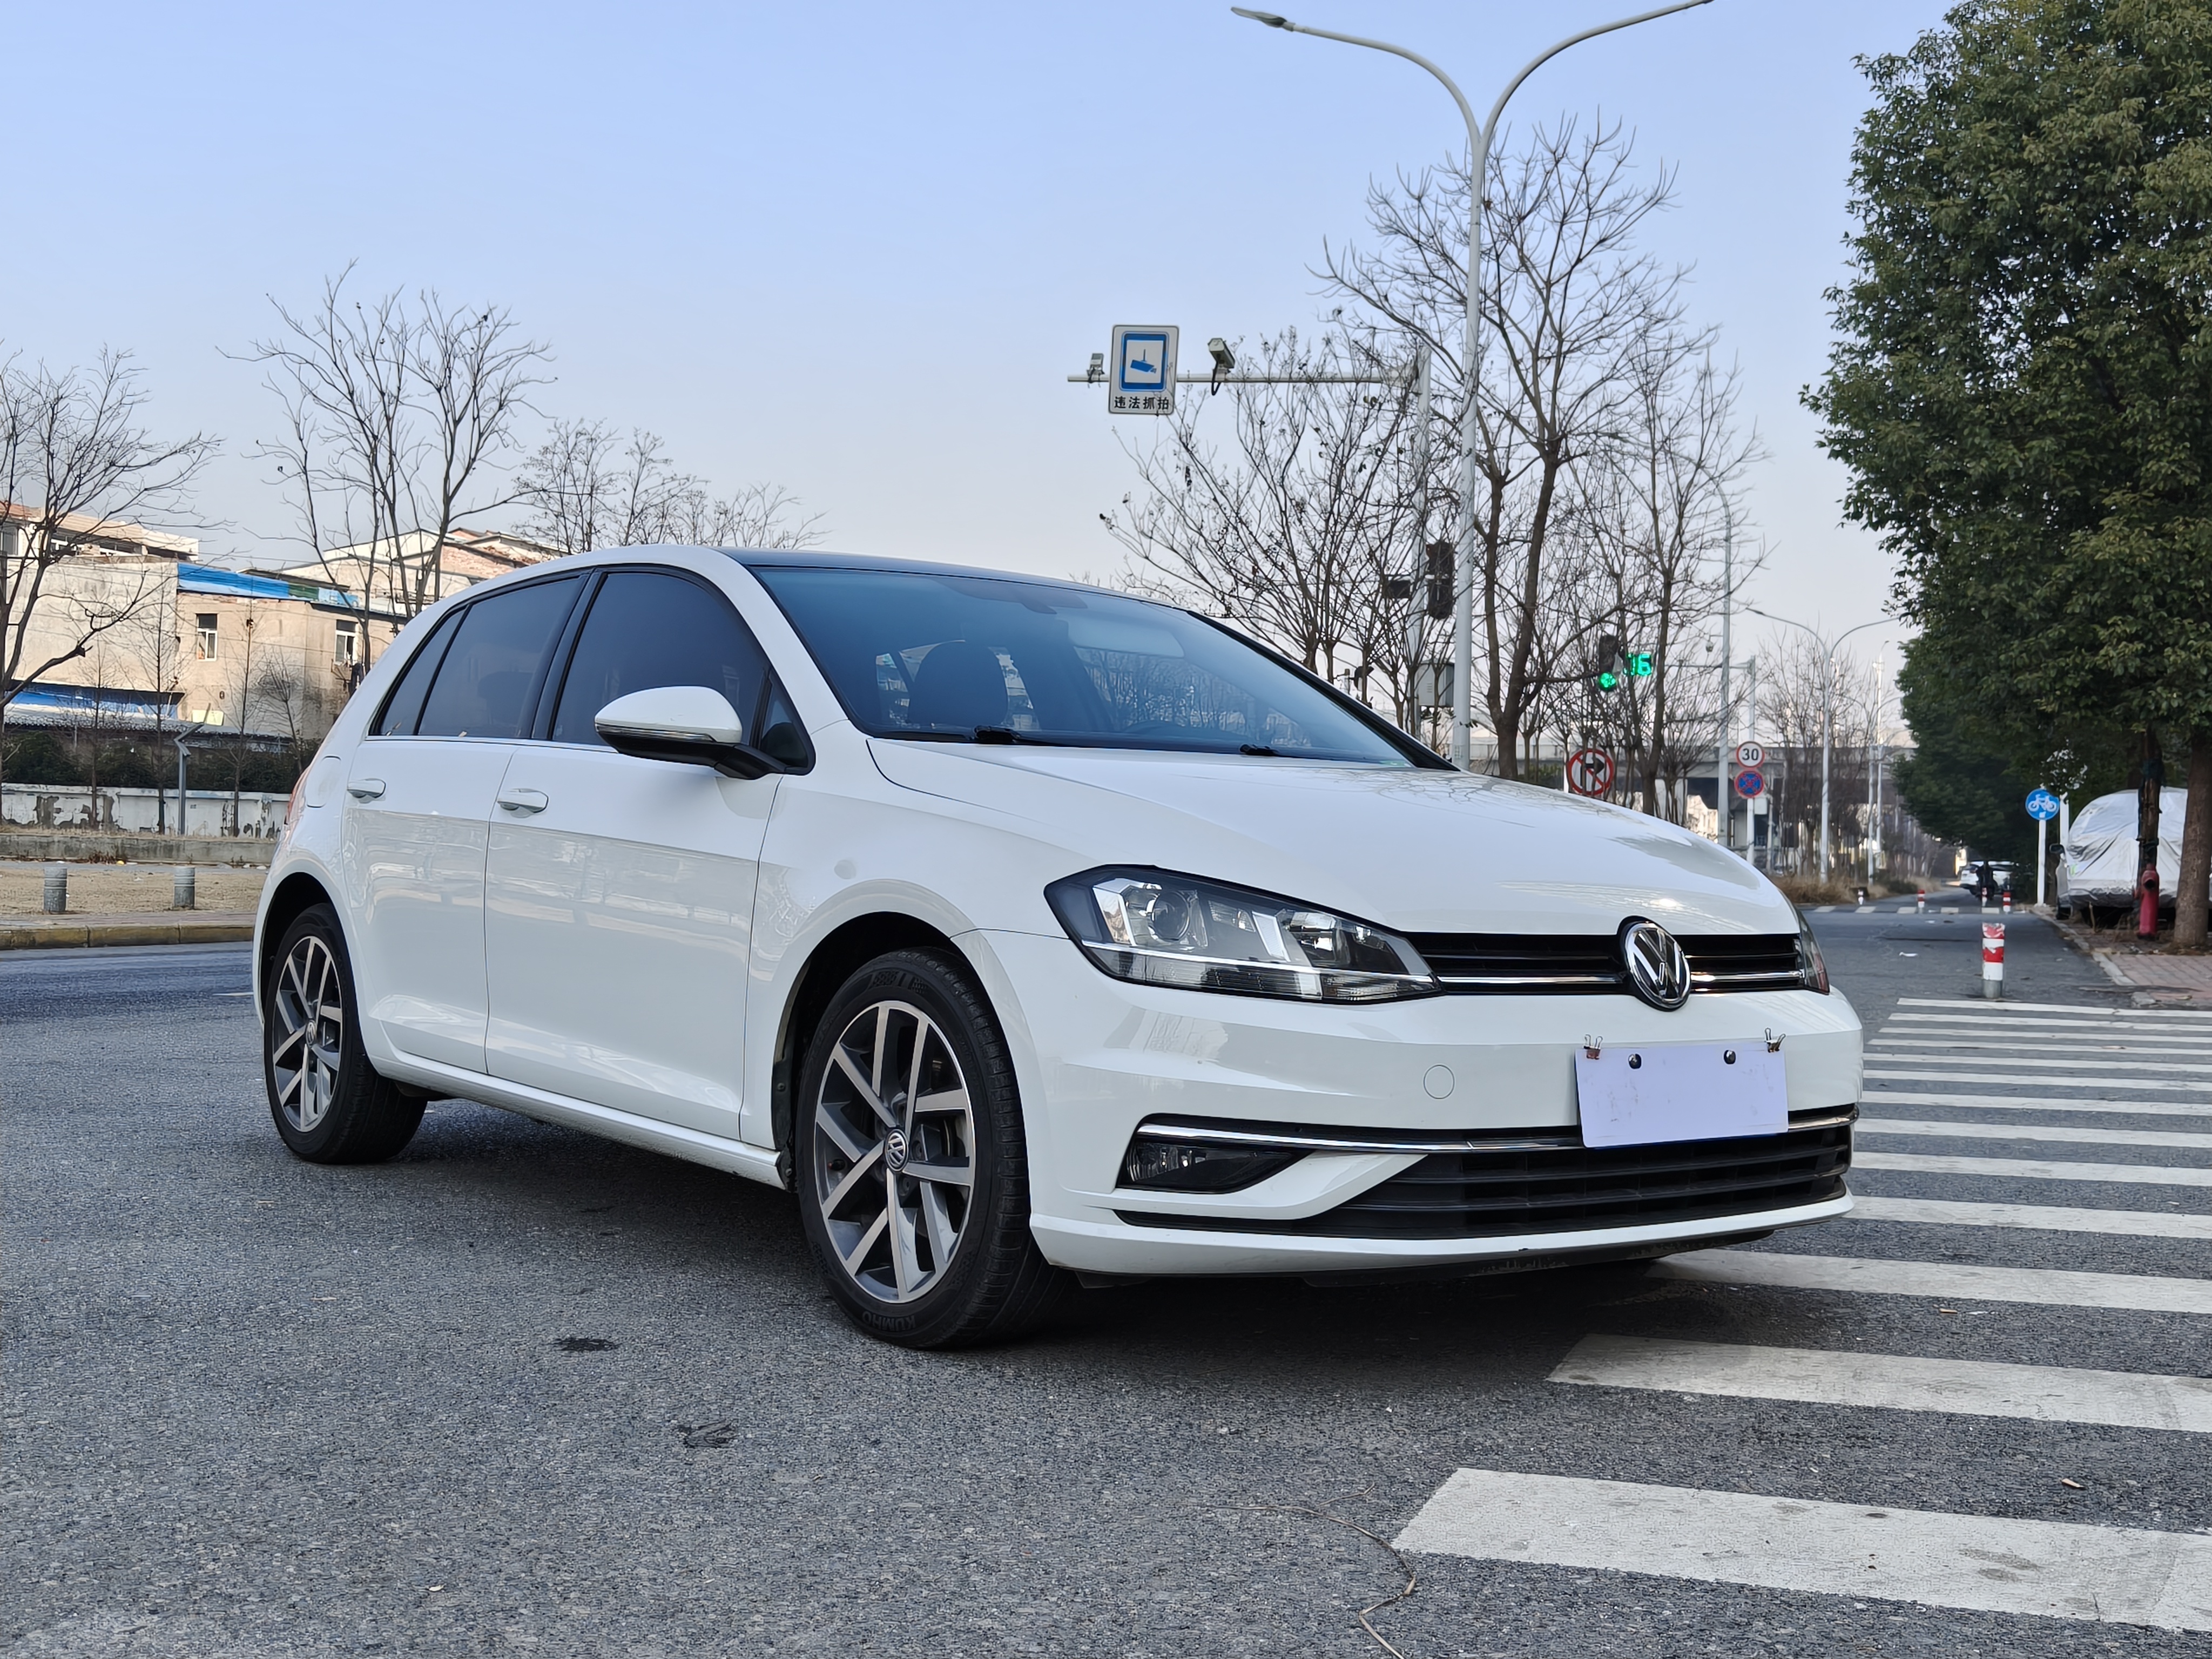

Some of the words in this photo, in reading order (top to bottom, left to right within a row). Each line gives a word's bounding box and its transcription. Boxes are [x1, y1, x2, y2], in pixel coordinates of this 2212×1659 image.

[1115, 396, 1169, 410] 违法抓拍
[1742, 748, 1759, 761] 30
[862, 1311, 916, 1331] KUMHO
